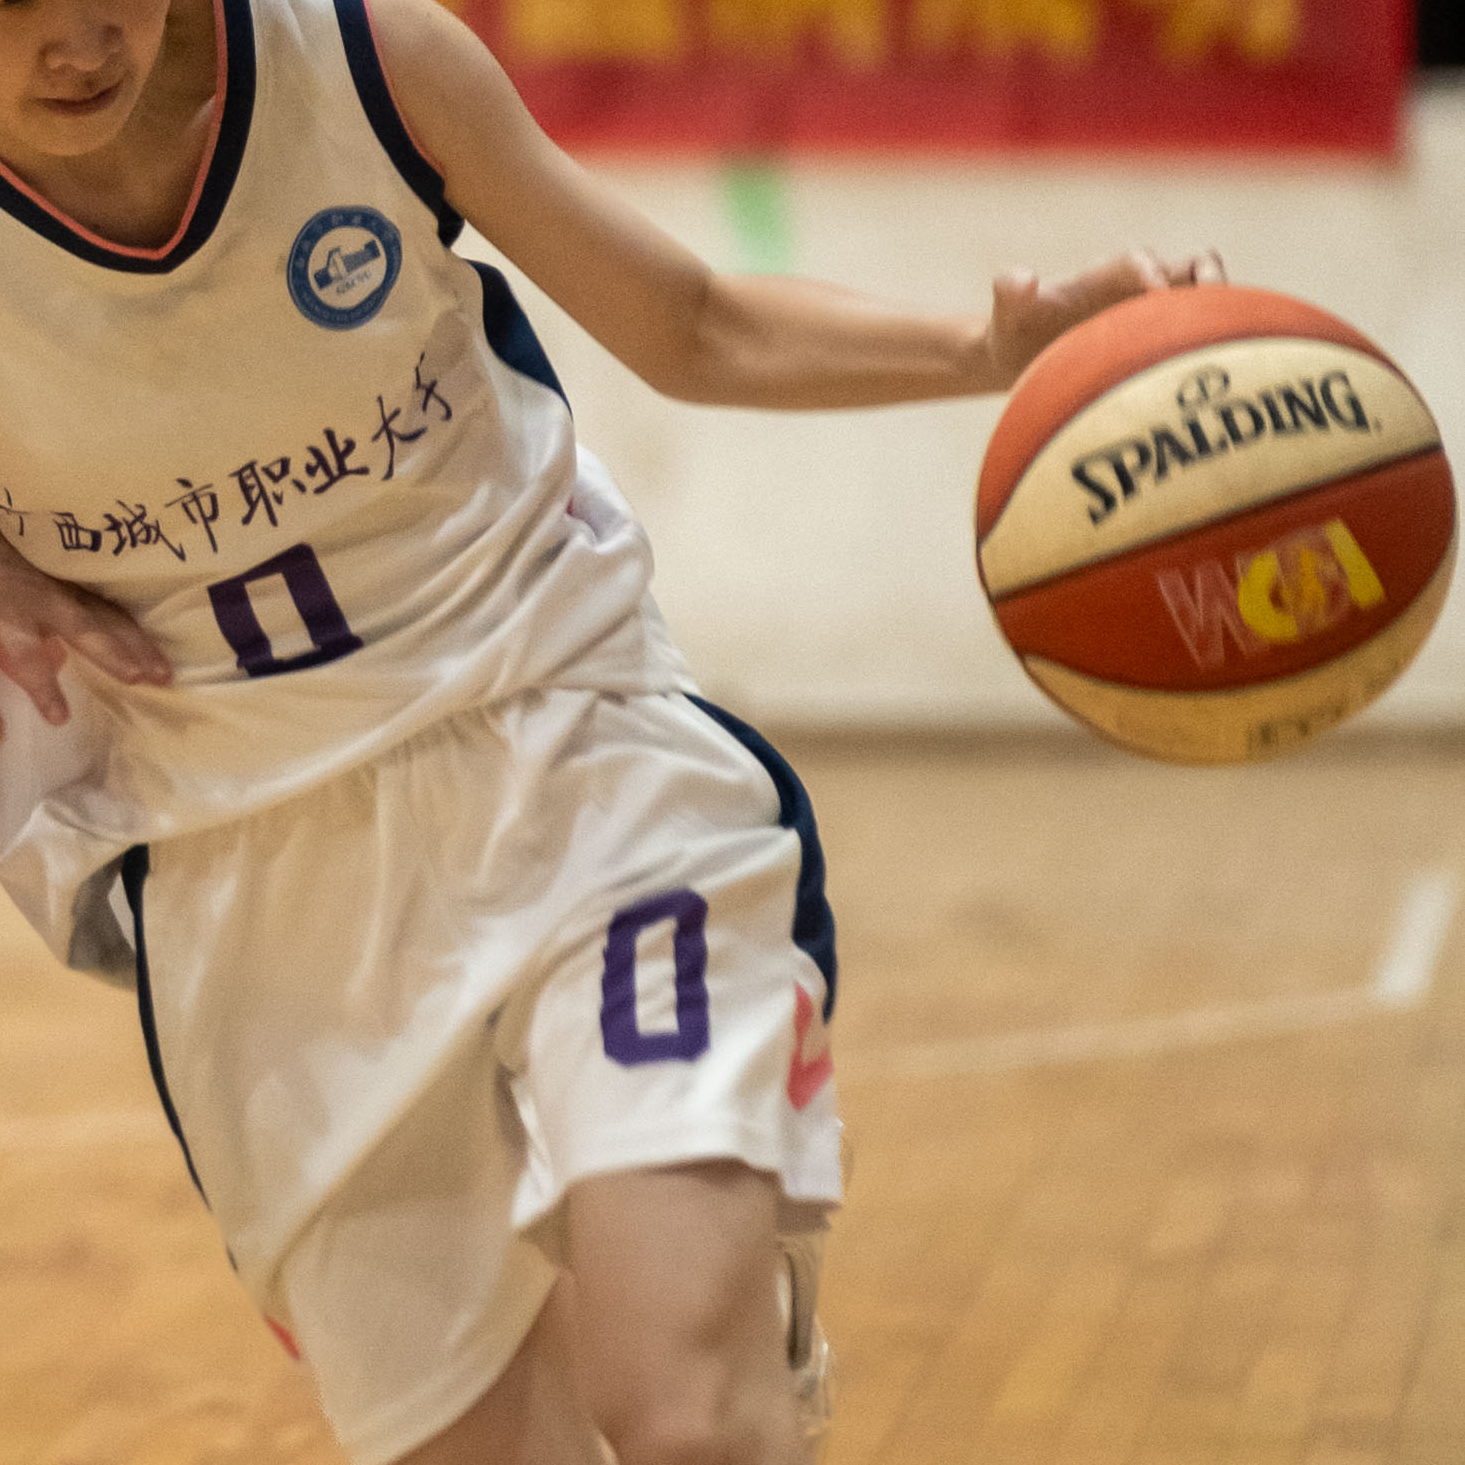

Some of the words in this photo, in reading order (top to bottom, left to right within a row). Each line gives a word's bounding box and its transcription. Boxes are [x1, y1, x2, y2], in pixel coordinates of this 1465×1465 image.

[1070, 369, 1372, 524] SPALDING
[207, 542, 364, 678] 0
[600, 887, 711, 1068] 0
